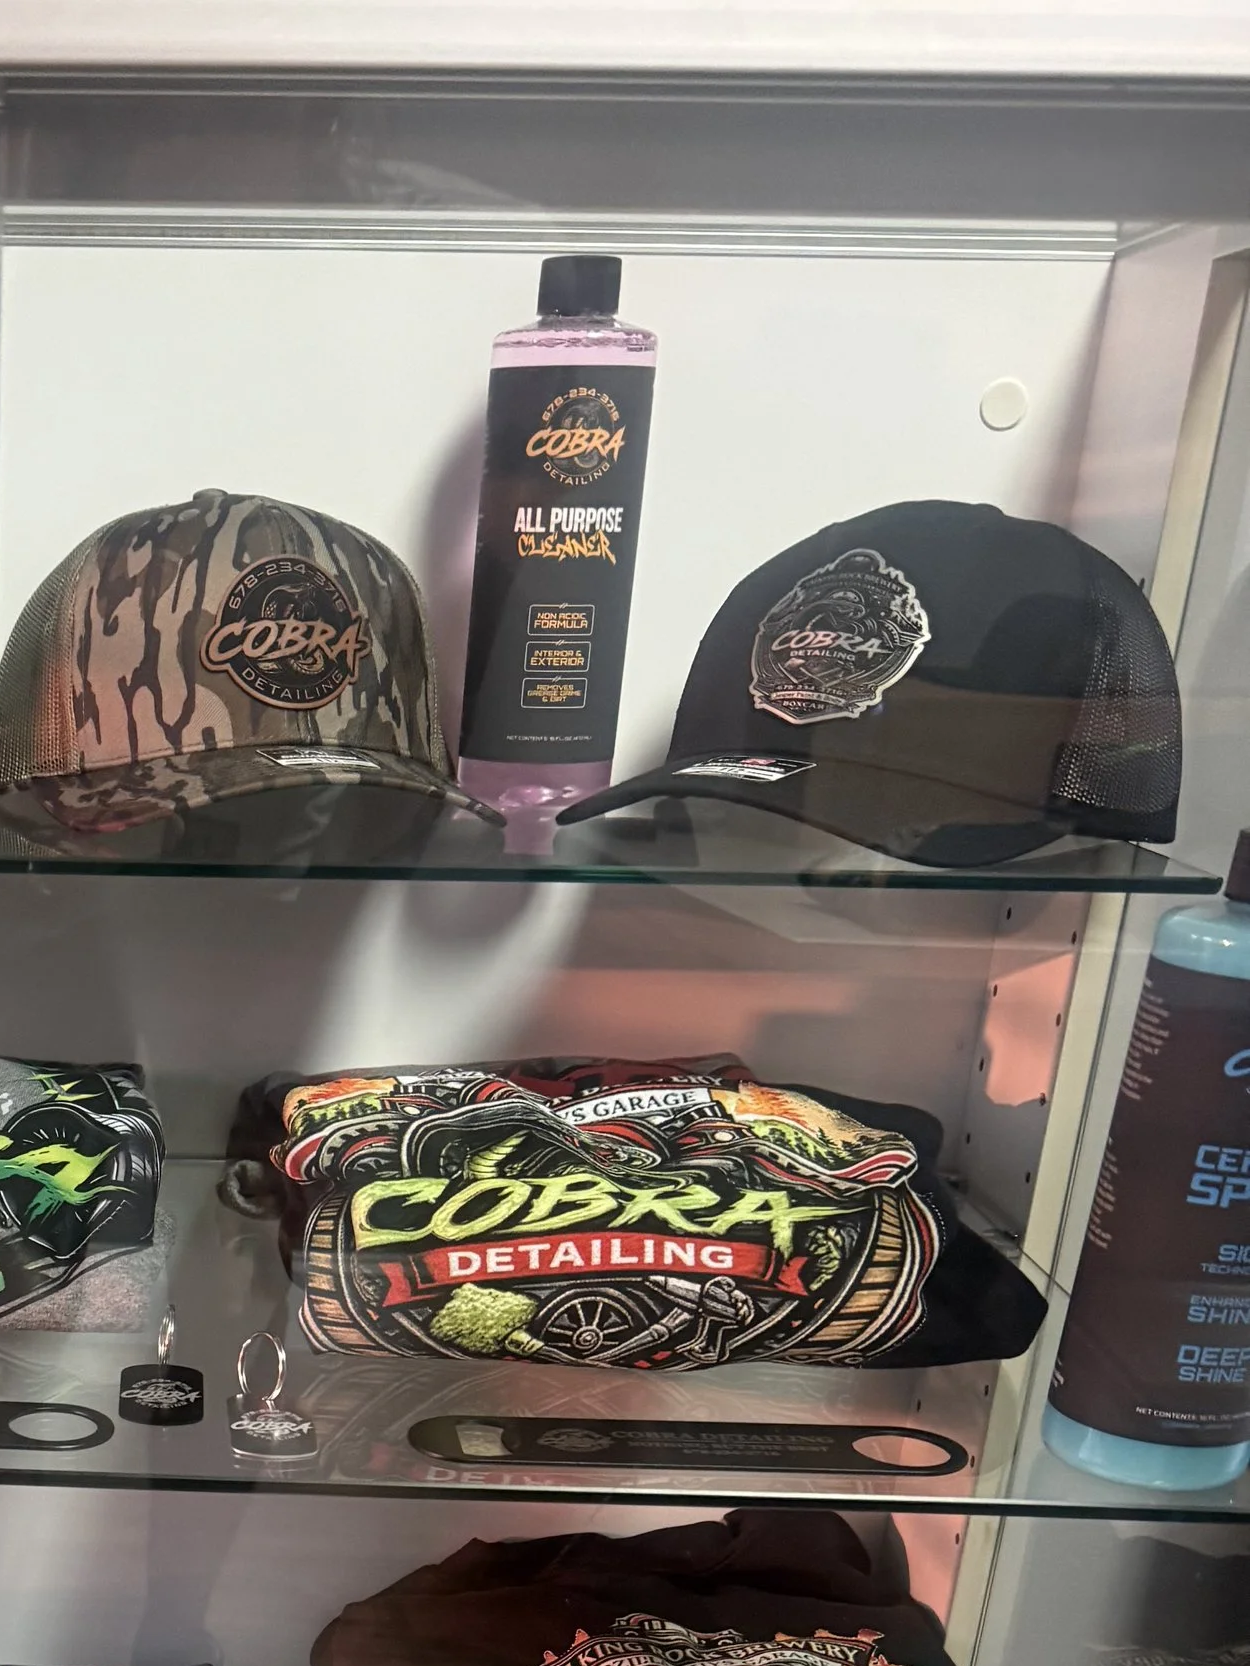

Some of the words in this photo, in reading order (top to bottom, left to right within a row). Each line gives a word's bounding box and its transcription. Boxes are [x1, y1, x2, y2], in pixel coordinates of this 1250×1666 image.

[541, 387, 621, 421] 678-234-3716
[525, 424, 626, 462] COBRA
[543, 461, 611, 486] DETAILING
[514, 507, 546, 533] ALL
[549, 507, 624, 533] PURPOSE
[518, 530, 617, 566] CLEANER
[228, 561, 348, 612] 678-234-3716
[533, 619, 589, 629] FORMULA
[537, 612, 557, 620] NON
[558, 612, 587, 620] ACIDIC
[208, 615, 366, 672] COBRA
[534, 649, 574, 657] INTERIOR
[771, 630, 894, 658] COBRA
[790, 650, 856, 662] DETAILING
[530, 657, 585, 666] EXTERIOR
[241, 668, 344, 700] DETAILING
[591, 1088, 697, 1121] GARAGE
[351, 1173, 870, 1256] COBRA
[447, 1236, 736, 1277] DETAILING
[1178, 1367, 1247, 1385] SHINE
[120, 1390, 202, 1403] COBRA
[1135, 1406, 1153, 1416] NET
[230, 1420, 314, 1434] COBRA
[611, 1430, 695, 1441] COBRA
[699, 1433, 835, 1445] DETAILING
[651, 1645, 720, 1664] ROCK
[726, 1640, 858, 1664] BREWERY
